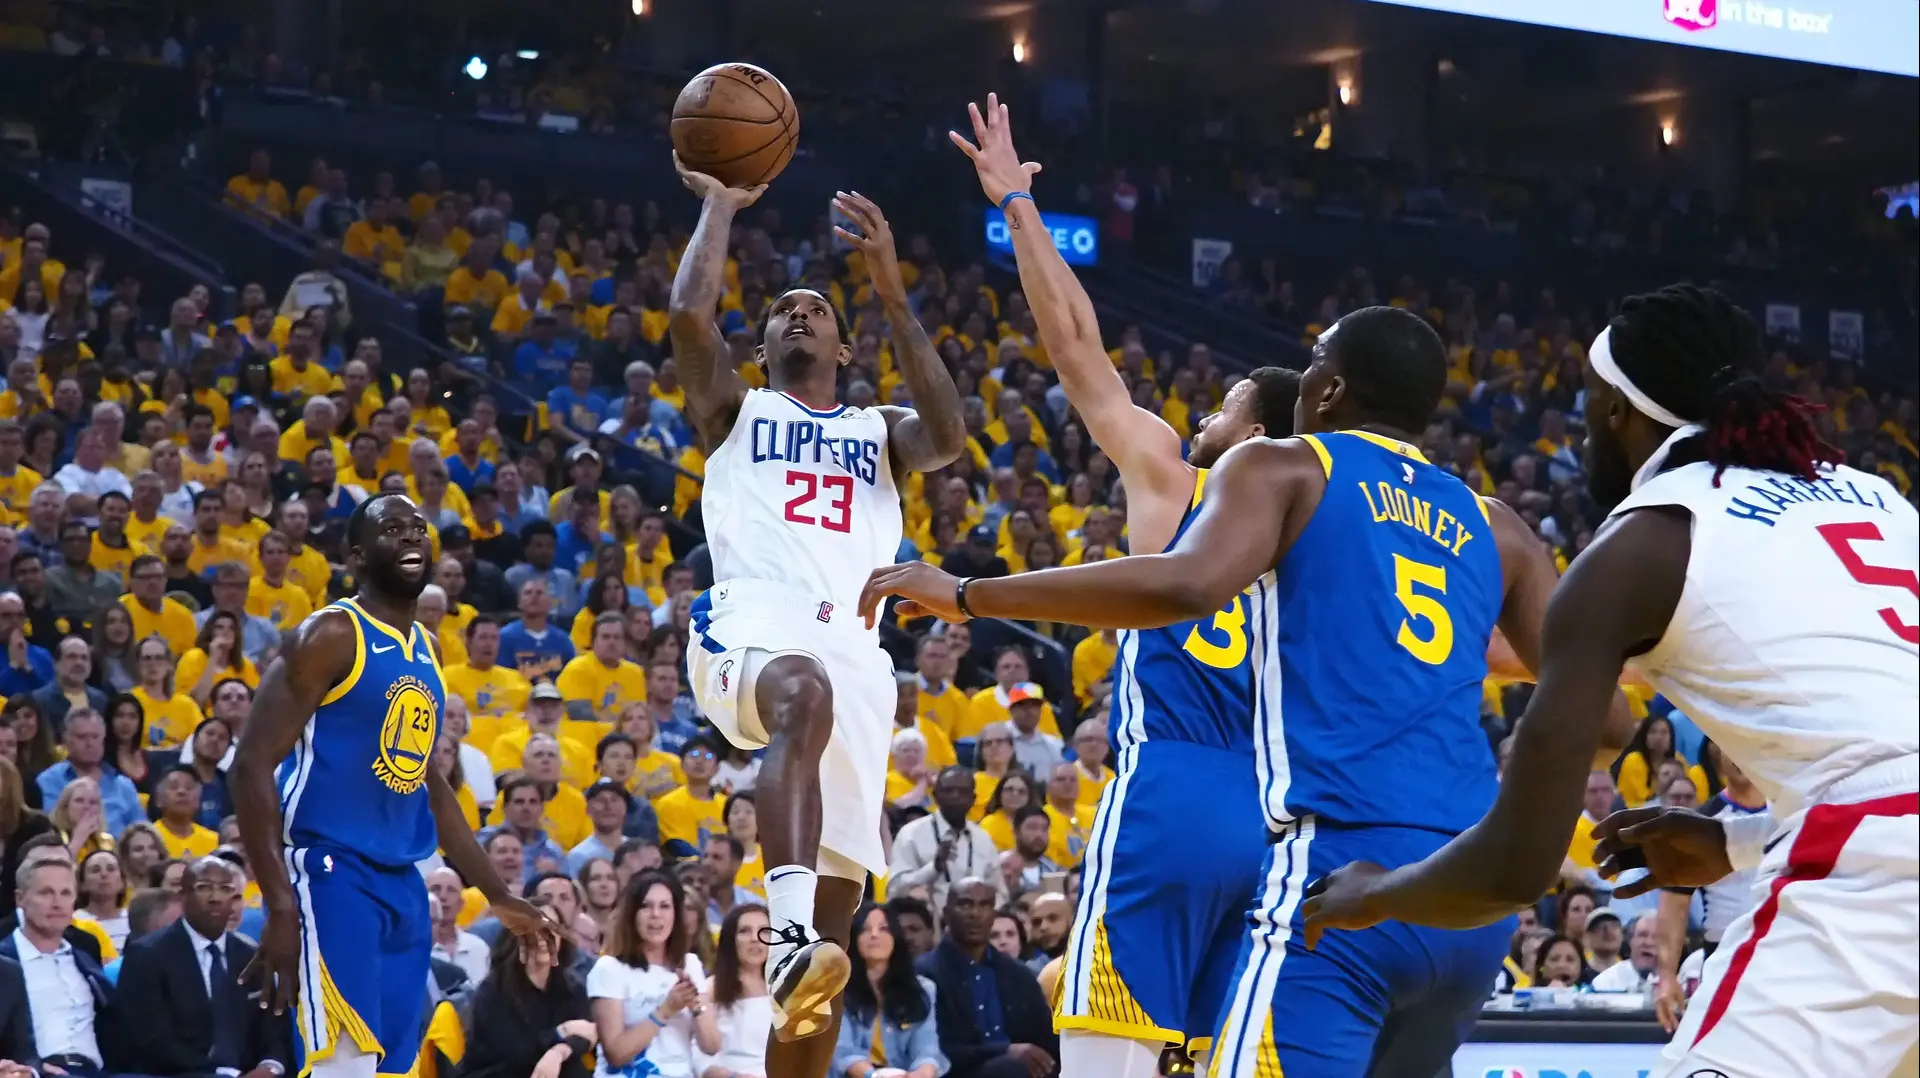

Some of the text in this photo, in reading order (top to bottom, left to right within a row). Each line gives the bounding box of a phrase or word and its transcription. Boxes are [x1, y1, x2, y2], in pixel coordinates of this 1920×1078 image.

[785, 470, 854, 533] 23
[1358, 481, 1473, 556] LOONEY
[1726, 476, 1892, 527] HARRELL
[1392, 553, 1454, 665] 5
[1815, 521, 1919, 644] 5
[385, 675, 416, 700] GOLDEN
[412, 707, 430, 732] 23
[371, 756, 427, 794] WARRIOR
